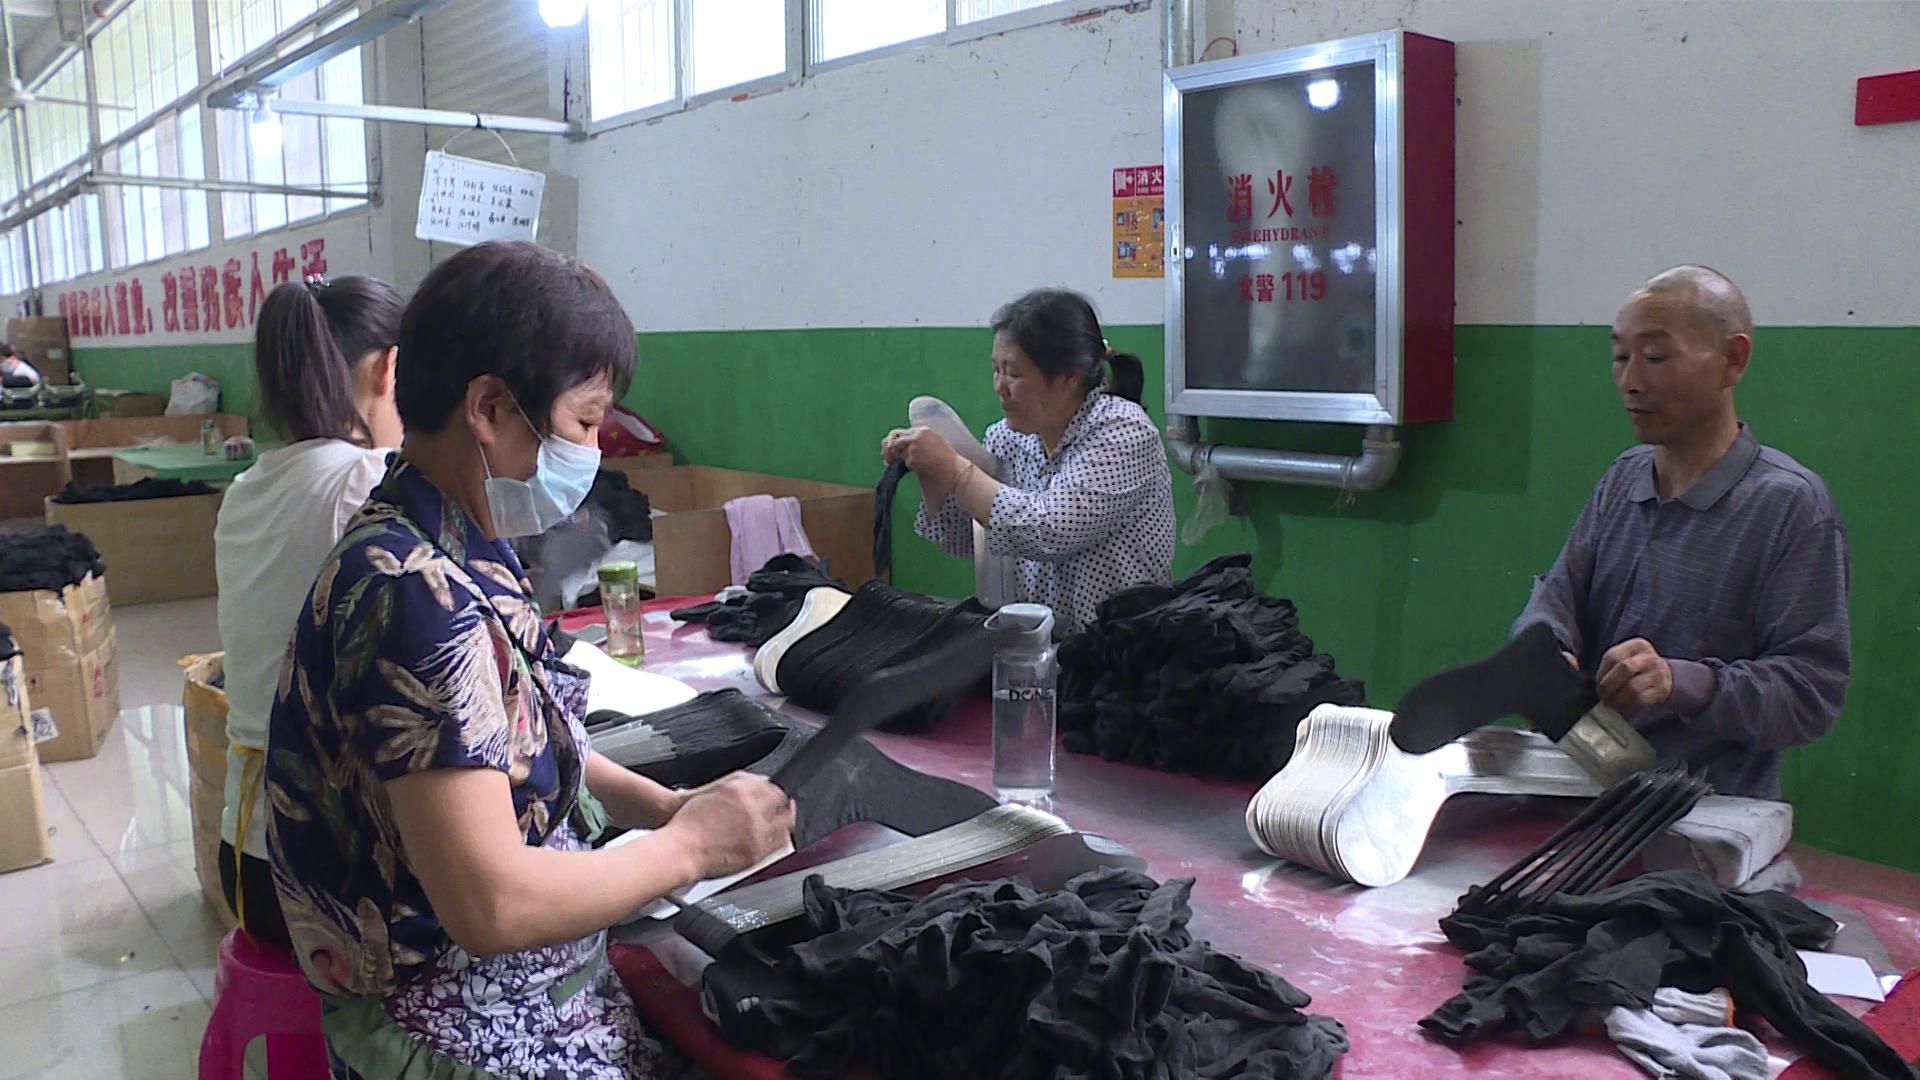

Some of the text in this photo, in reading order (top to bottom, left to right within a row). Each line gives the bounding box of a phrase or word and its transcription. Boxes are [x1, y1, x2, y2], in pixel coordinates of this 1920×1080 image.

[1226, 165, 1337, 223] 消火栓
[1281, 271, 1328, 301] 119
